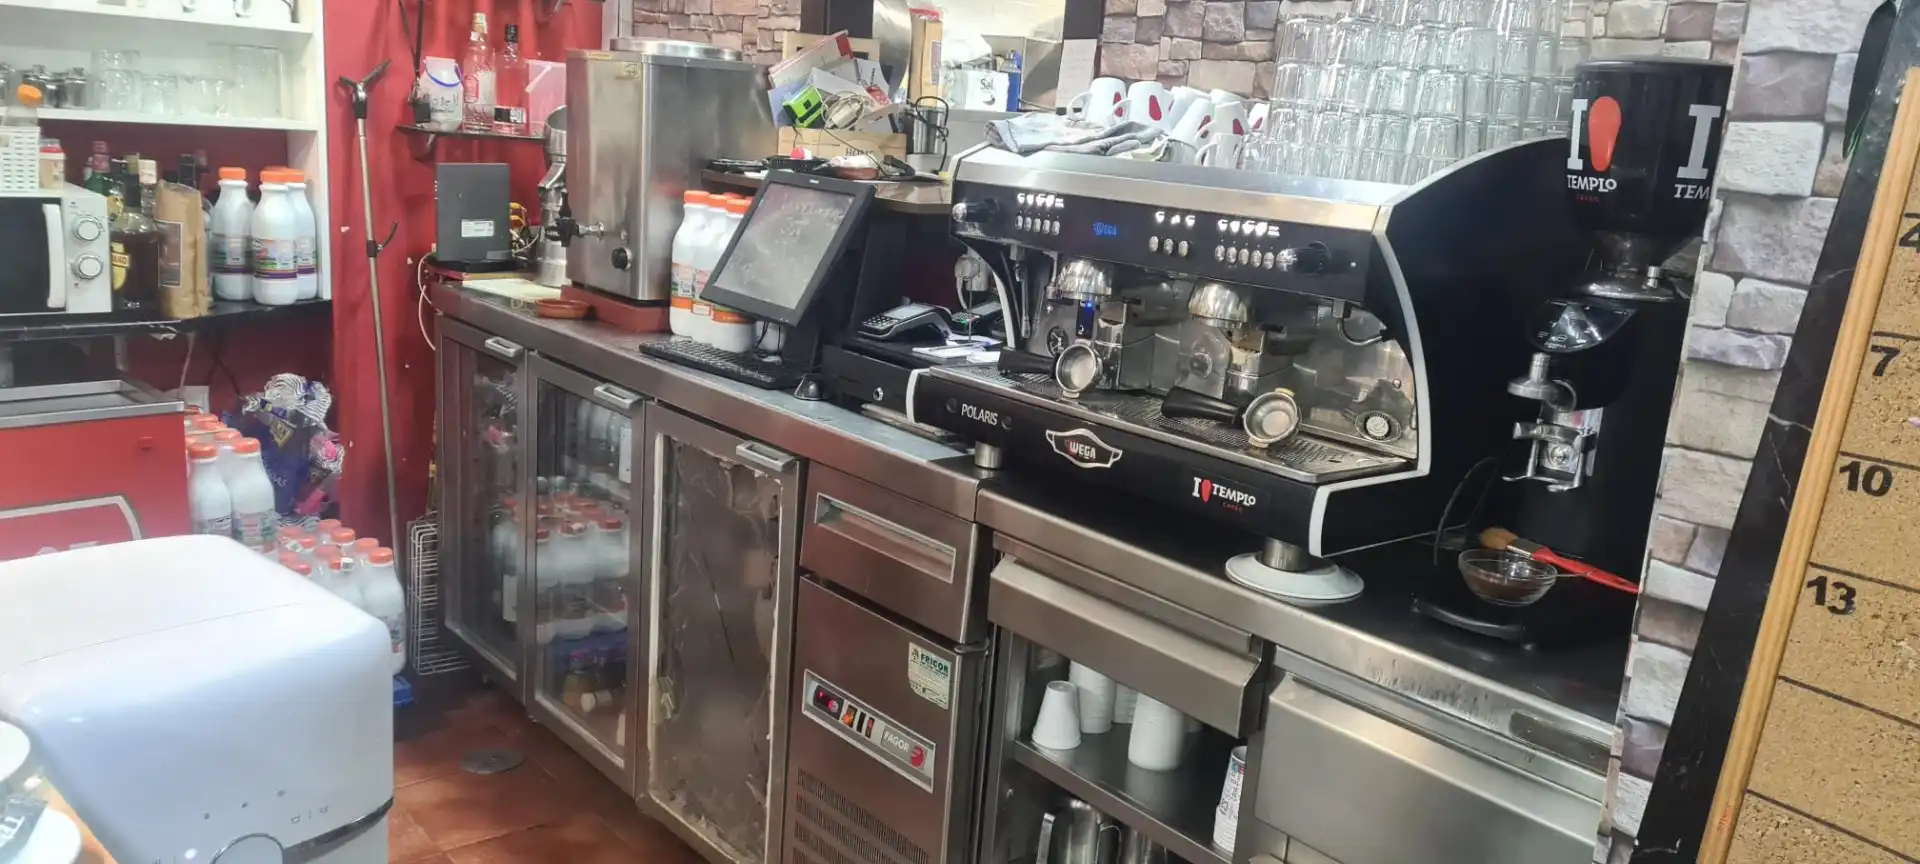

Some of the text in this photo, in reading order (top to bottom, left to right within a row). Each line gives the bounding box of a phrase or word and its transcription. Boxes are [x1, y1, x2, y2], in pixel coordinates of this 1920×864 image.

[980, 78, 993, 90] Sal
[1566, 174, 1618, 192] TEMPLO
[1870, 344, 1900, 377] 7
[961, 403, 999, 426] POLARIS
[1069, 440, 1097, 459] WEGA
[1839, 460, 1893, 497] 10
[1212, 483, 1257, 507] TEMPLO
[1807, 575, 1857, 615] 13
[883, 730, 910, 752] FAGOR
